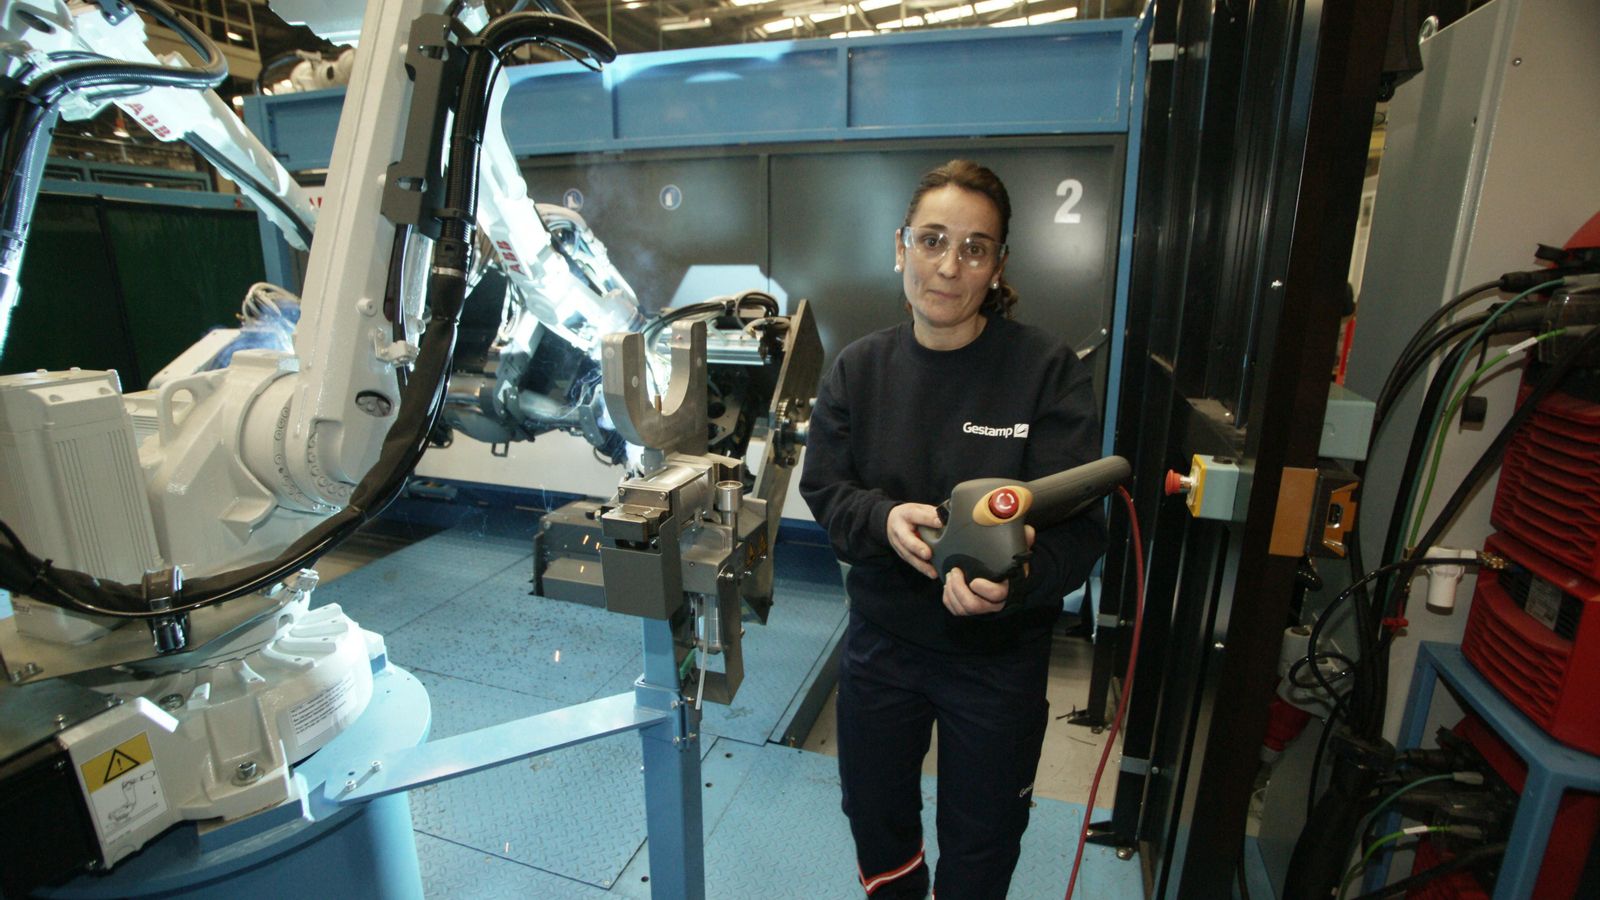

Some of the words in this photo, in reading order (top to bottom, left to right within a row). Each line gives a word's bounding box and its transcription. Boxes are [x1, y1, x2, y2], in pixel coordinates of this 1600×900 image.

[123, 103, 171, 138] ABB
[1054, 179, 1083, 223] 2
[496, 240, 527, 276] ABB
[963, 421, 1013, 438] Gestamp
